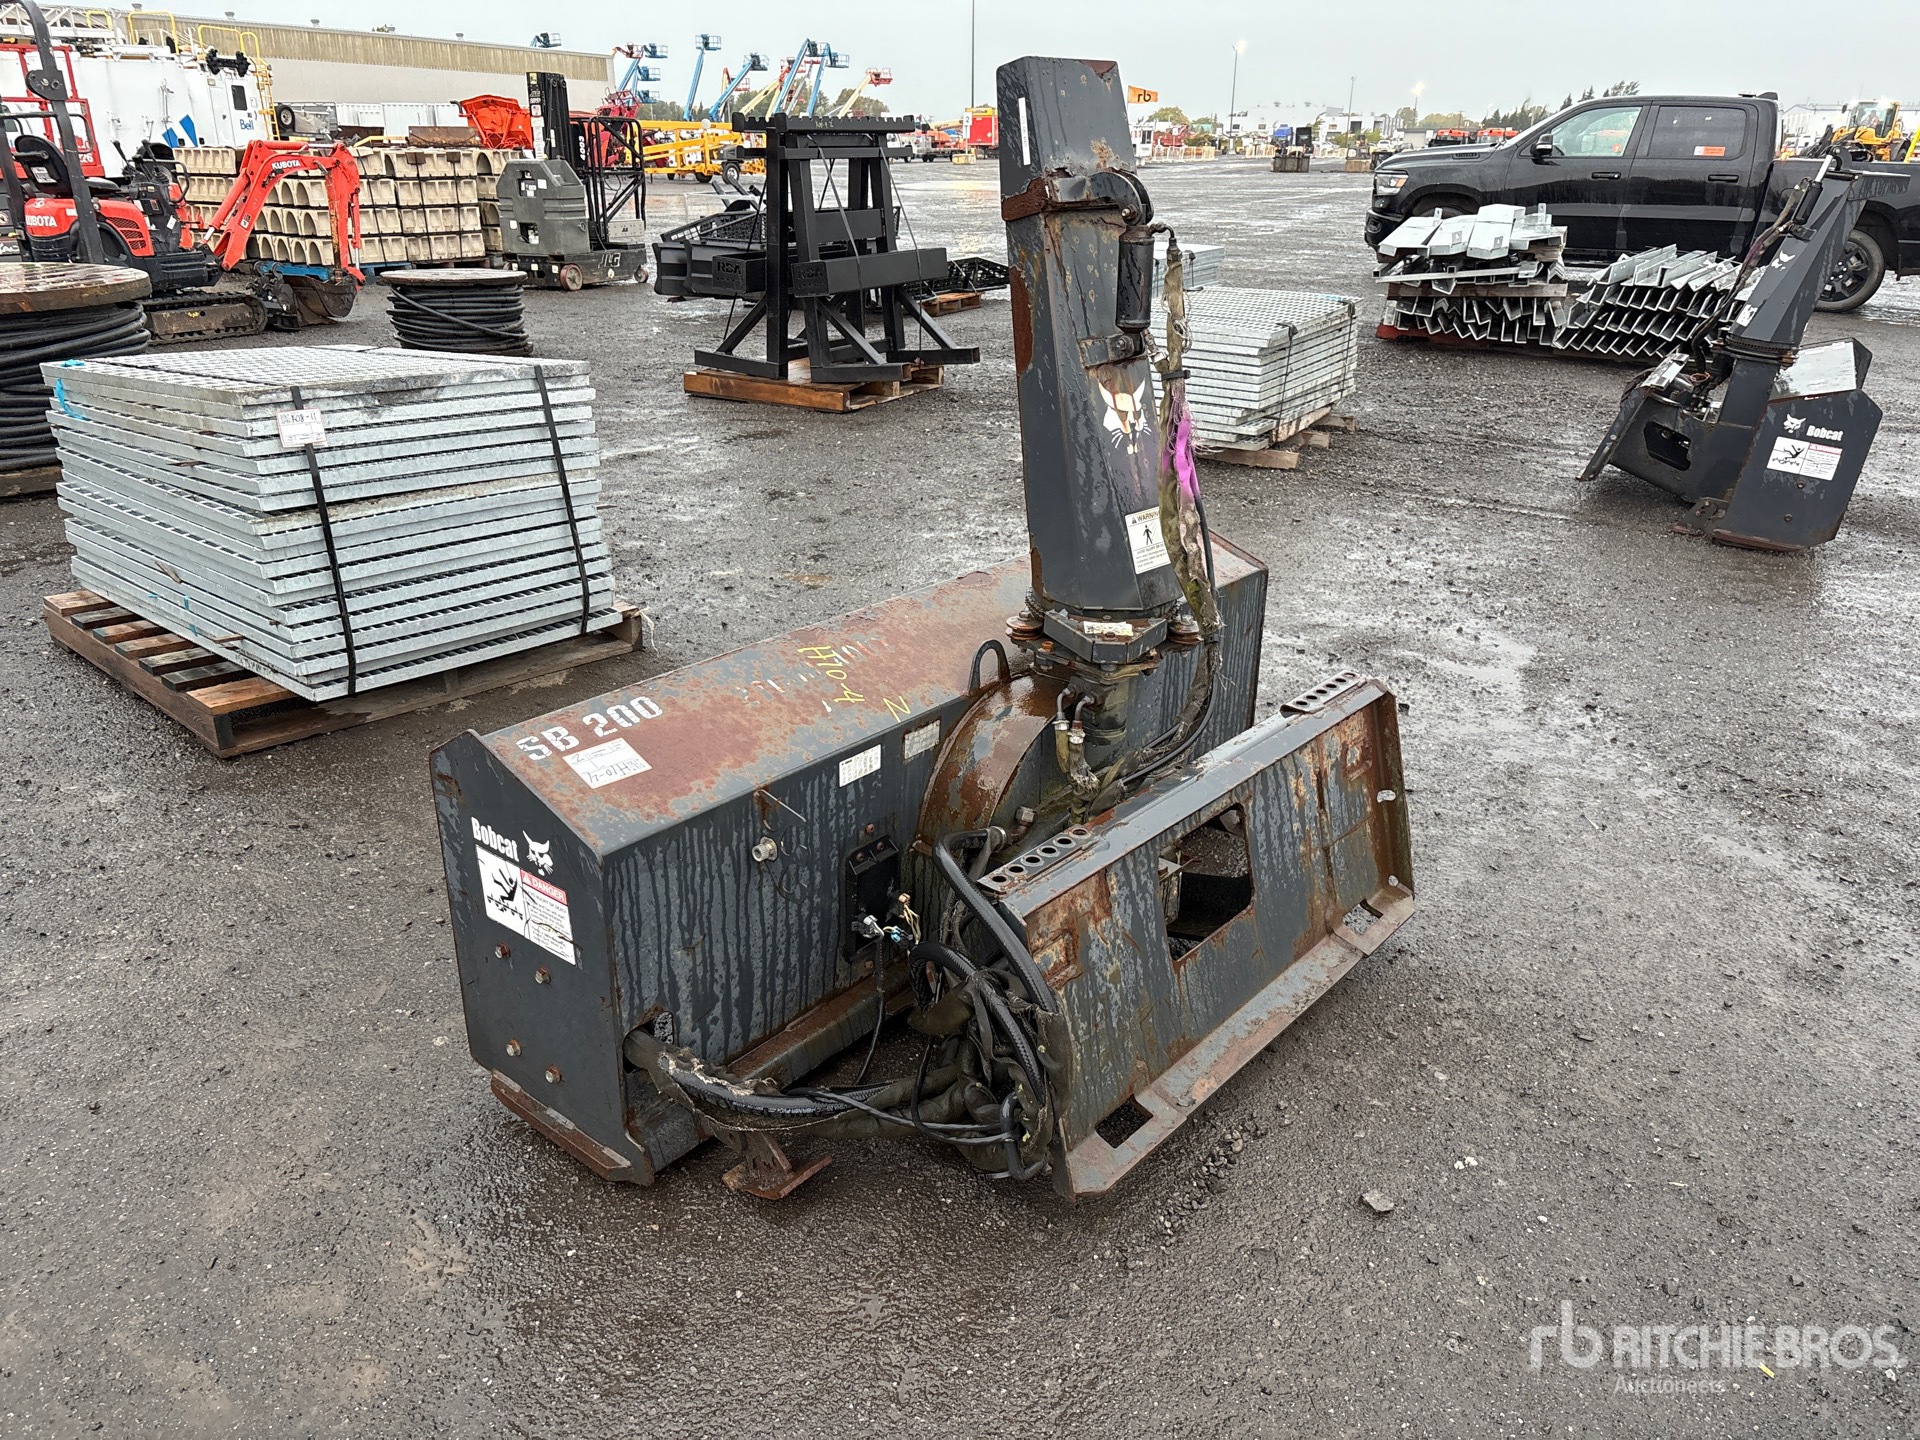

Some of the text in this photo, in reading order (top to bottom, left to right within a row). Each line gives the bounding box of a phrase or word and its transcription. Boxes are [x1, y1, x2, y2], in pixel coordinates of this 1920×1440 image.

[1137, 90, 1151, 102] rb
[239, 119, 254, 130] Bell
[578, 135, 587, 161] 4003
[271, 160, 302, 170] KUBOTA
[1806, 425, 1844, 441] Bobcat
[1137, 511, 1159, 521] WARNIN
[515, 696, 663, 760] SB 200
[471, 816, 520, 863] Bobcat
[531, 876, 565, 902] DANGER
